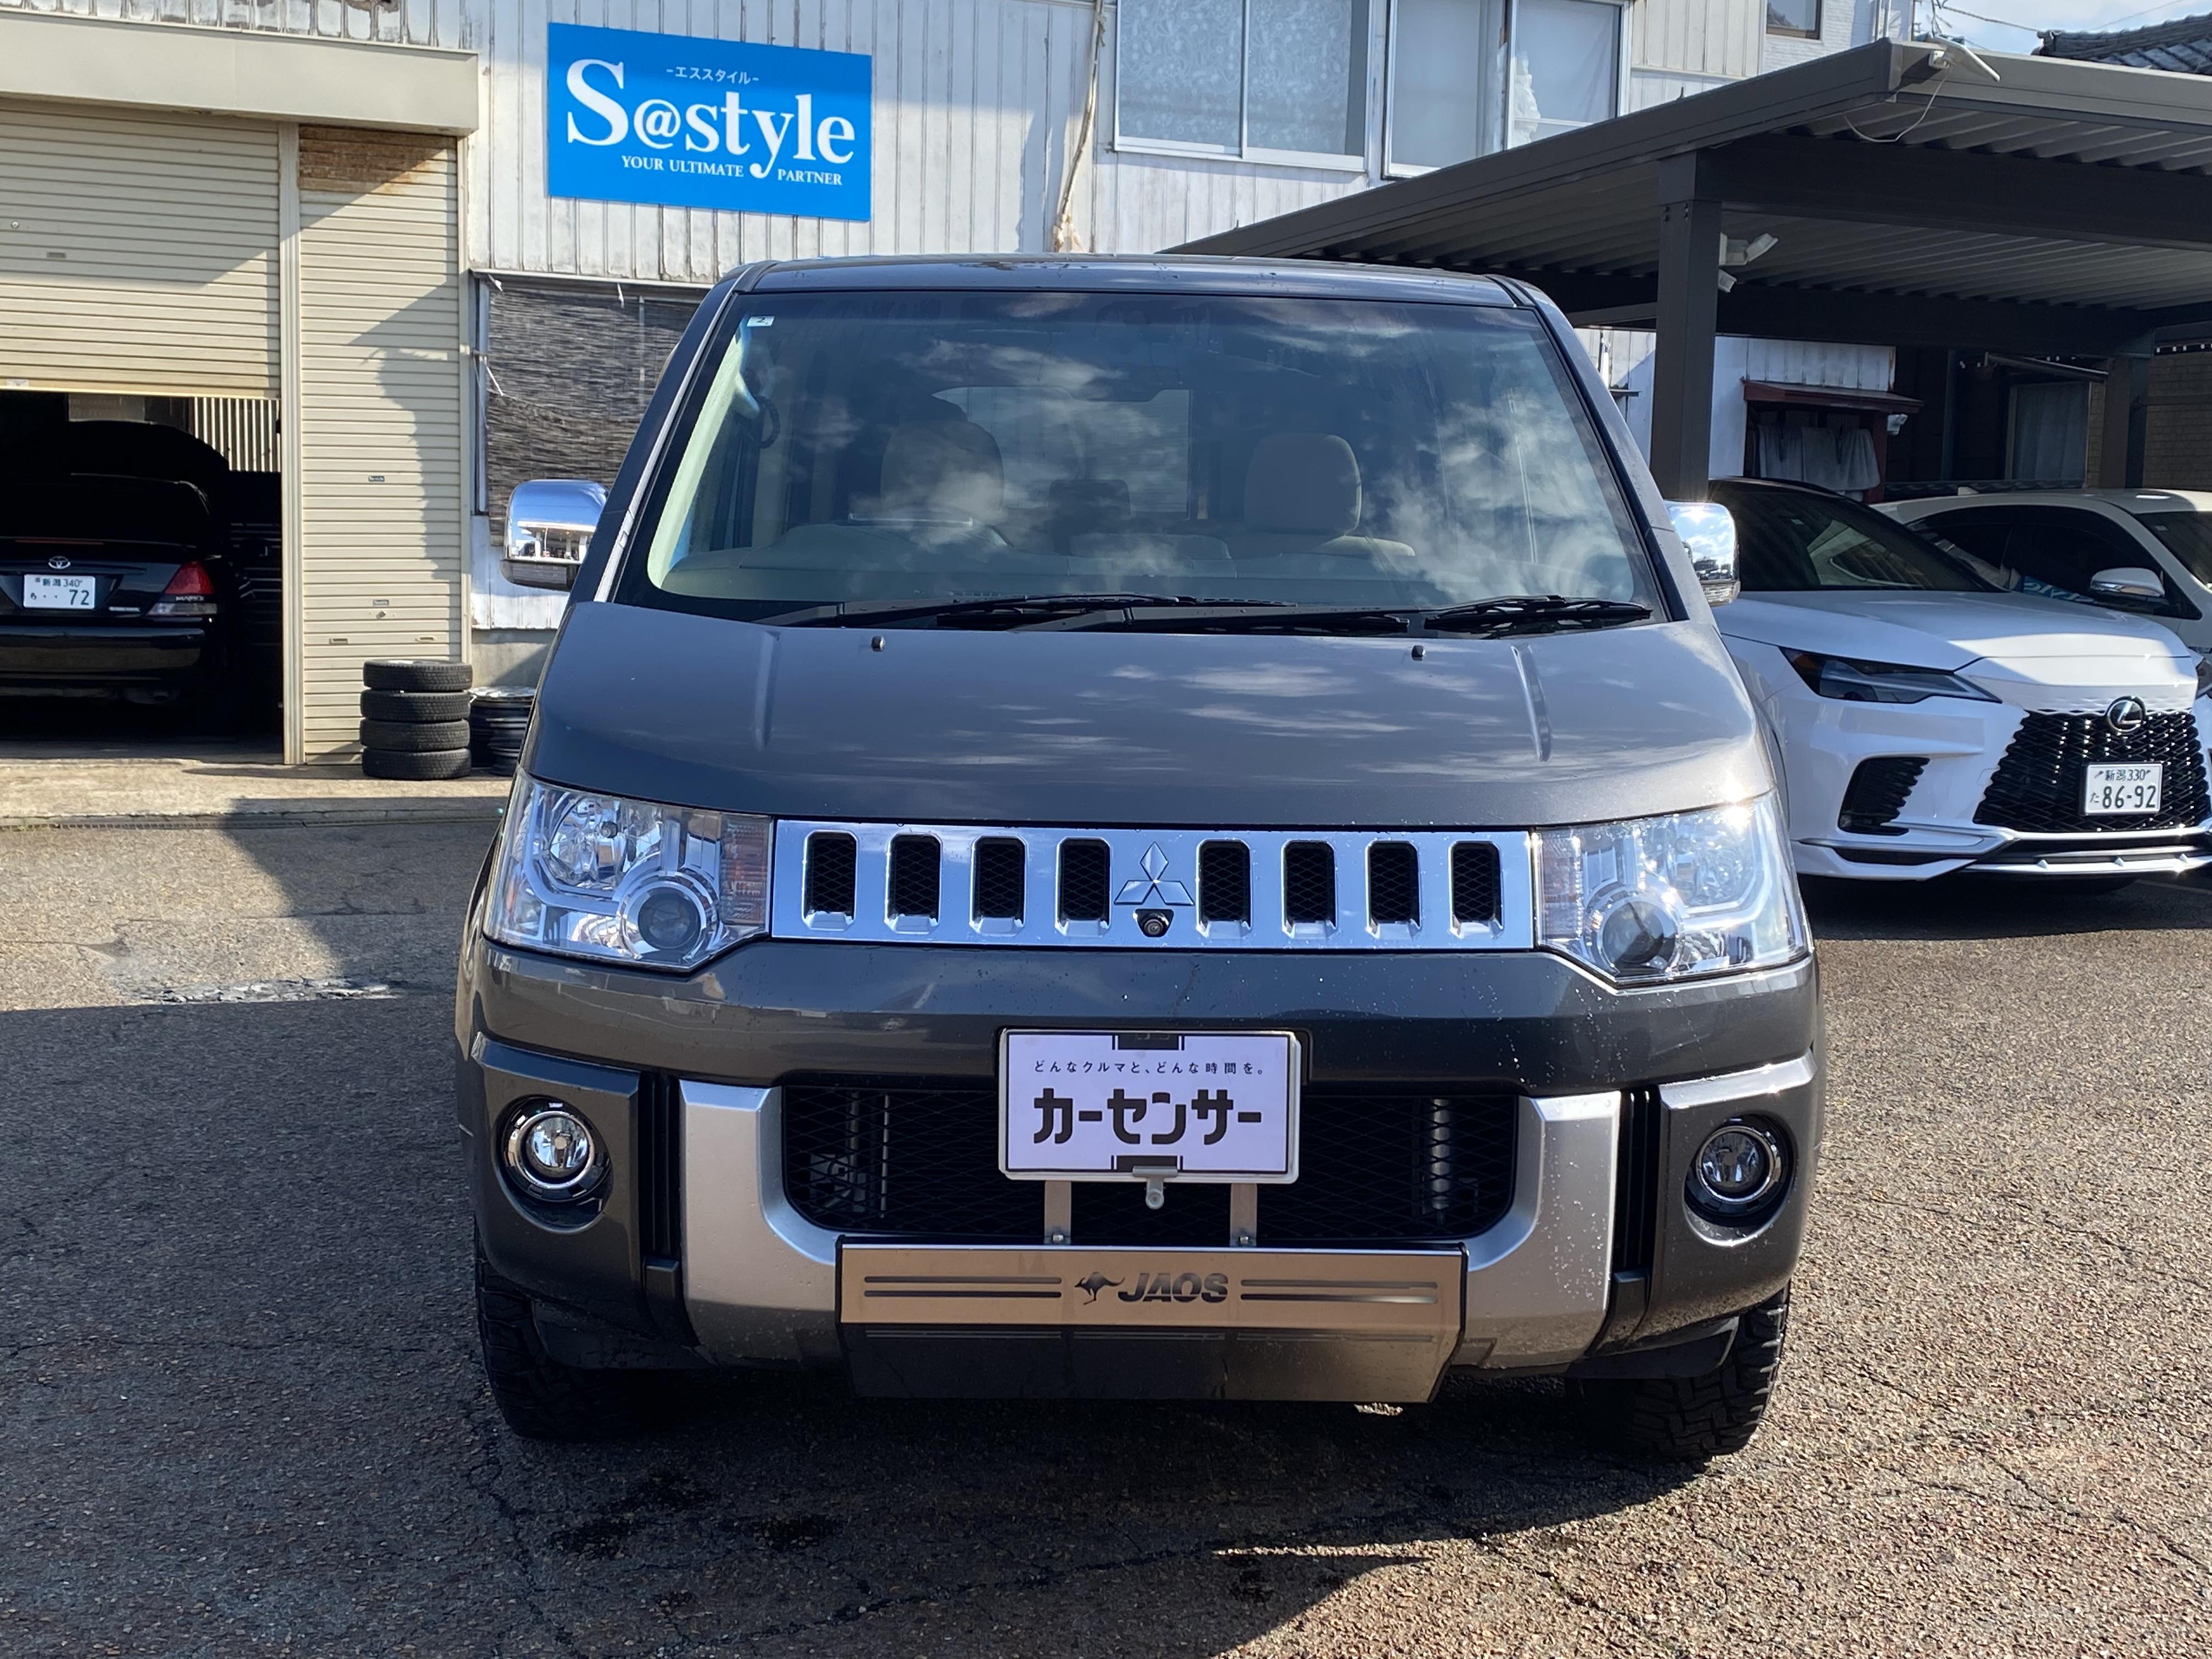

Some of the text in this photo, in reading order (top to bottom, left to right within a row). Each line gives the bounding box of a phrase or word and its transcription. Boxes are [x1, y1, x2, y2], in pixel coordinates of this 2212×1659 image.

[566, 58, 855, 178] S@style
[622, 155, 843, 185] YOUR ULTIMATE PARTNER
[1034, 1060, 1263, 1075] どんなクルマと、どんな時間を。
[1034, 1088, 1262, 1145] カーセンサー
[1118, 1272, 1228, 1303] JAOS
